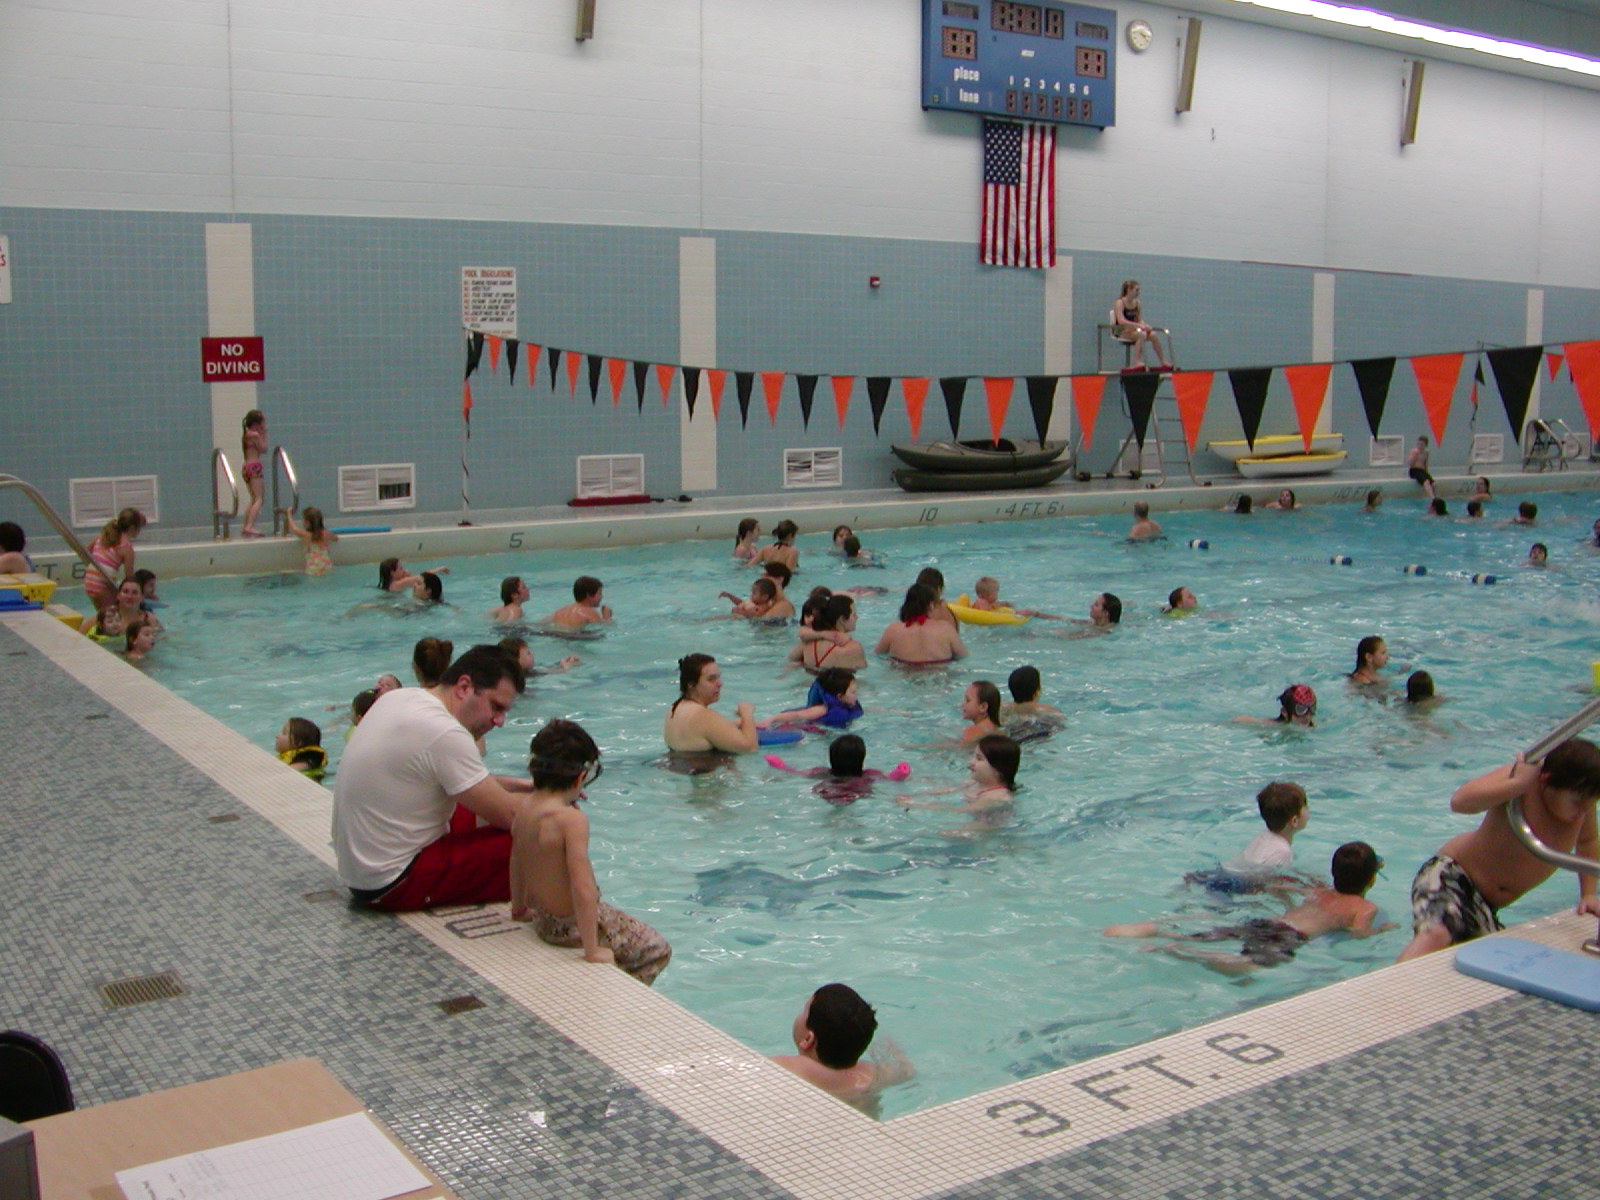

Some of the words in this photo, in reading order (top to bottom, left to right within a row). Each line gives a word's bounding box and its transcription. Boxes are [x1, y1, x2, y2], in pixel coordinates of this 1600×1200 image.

[953, 66, 980, 81] place
[1009, 75, 1015, 86] 1
[1023, 77, 1031, 88] 2
[1039, 79, 1046, 90] 3
[1053, 81, 1061, 92] 4
[1069, 83, 1076, 94] 5
[1082, 85, 1090, 96] 6
[959, 88, 979, 104] lane
[220, 343, 245, 357] NO
[206, 360, 261, 375] DIVING
[919, 507, 939, 523] 10
[1004, 502, 1017, 517] 4
[1047, 500, 1060, 515] 6
[509, 531, 525, 549] 5
[986, 1100, 1071, 1138] 3
[1070, 1054, 1223, 1112] FT.
[1205, 1032, 1285, 1064] 6
